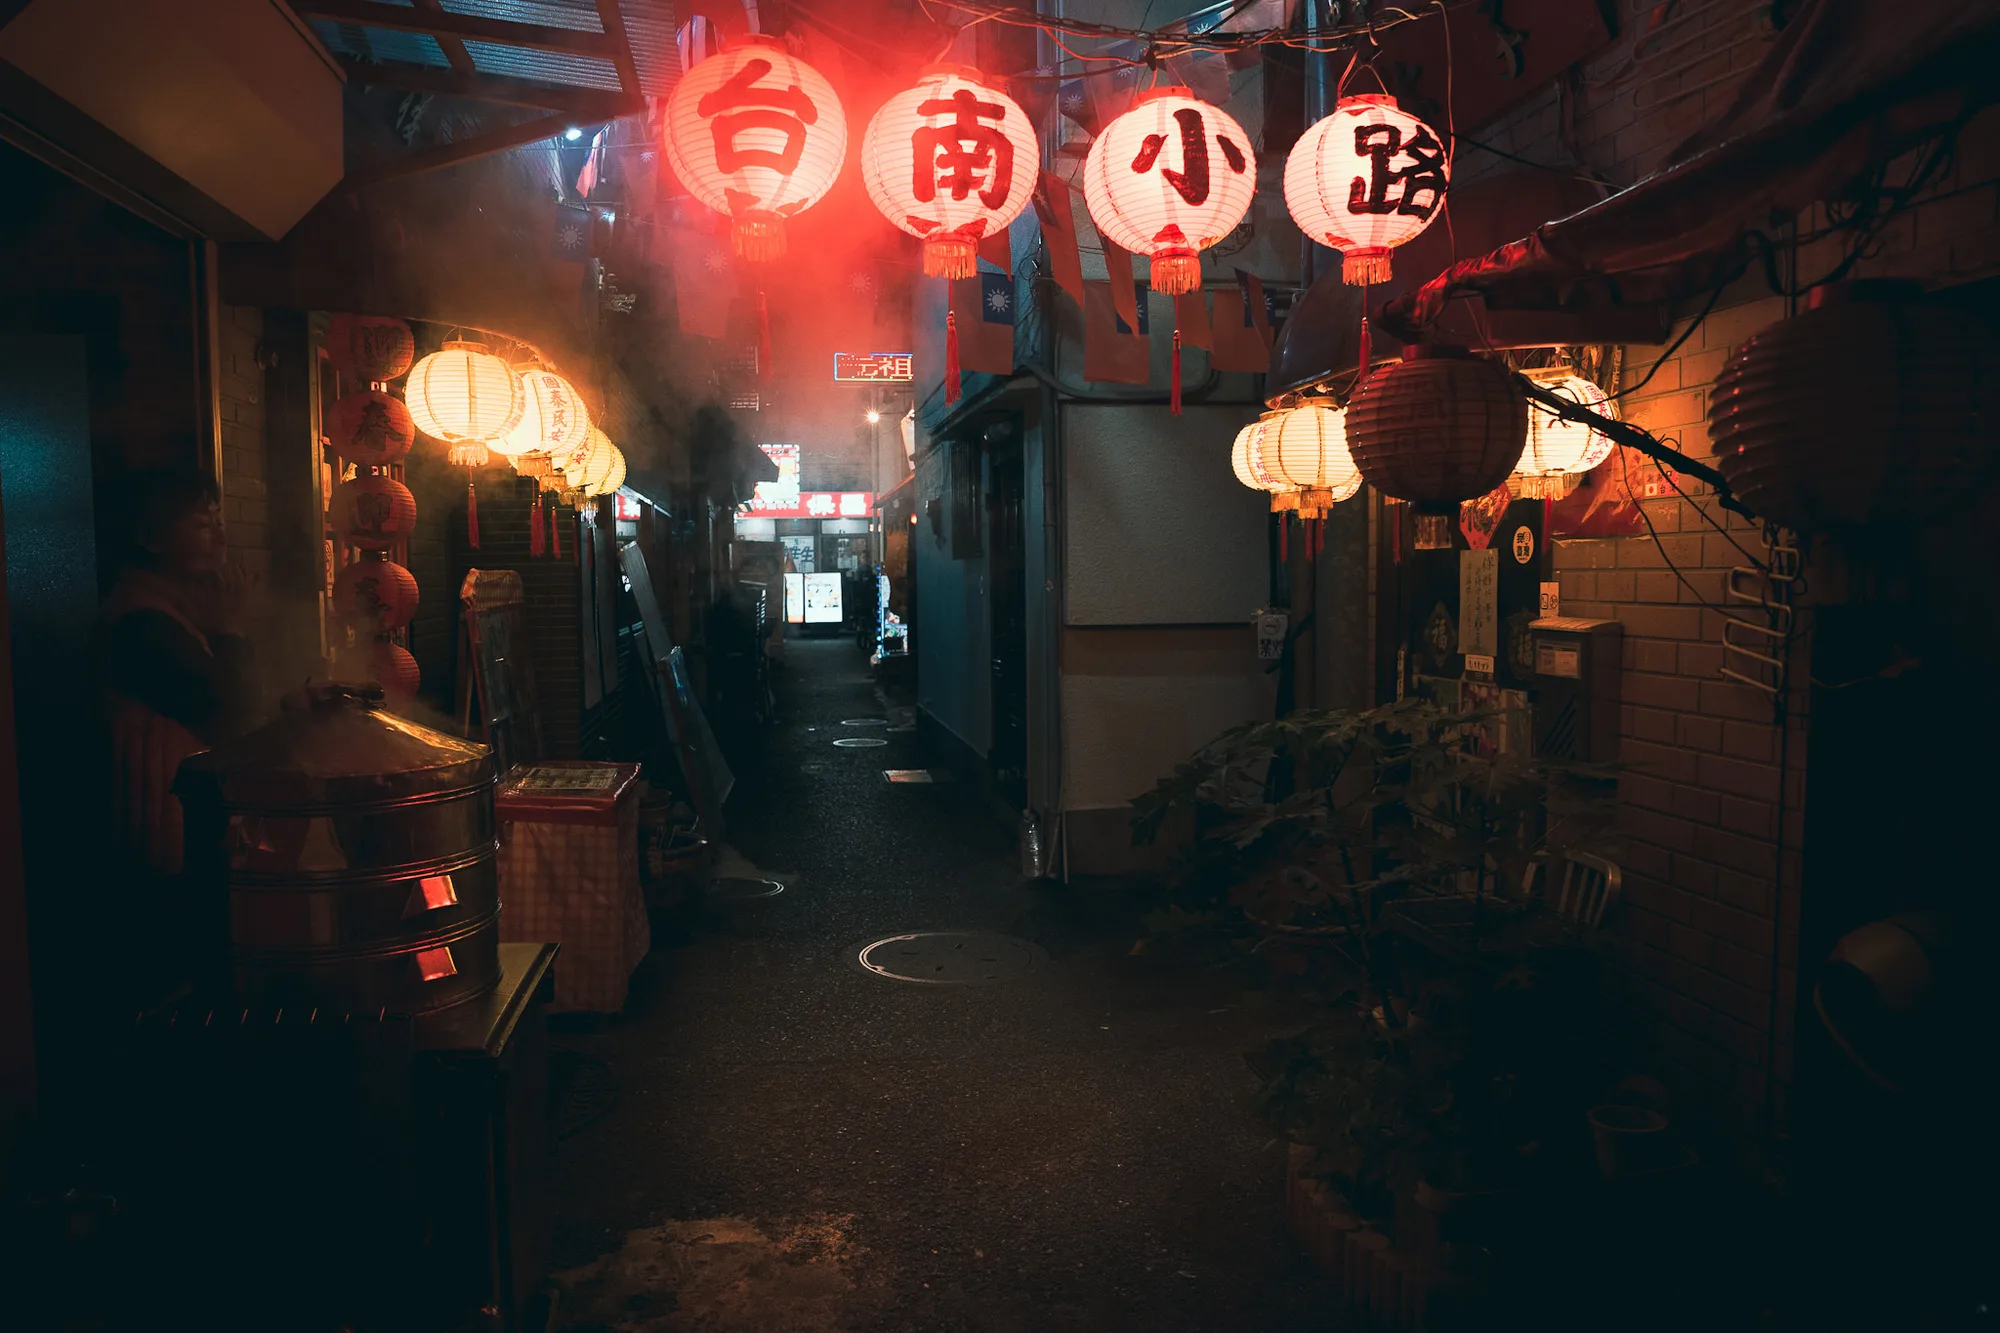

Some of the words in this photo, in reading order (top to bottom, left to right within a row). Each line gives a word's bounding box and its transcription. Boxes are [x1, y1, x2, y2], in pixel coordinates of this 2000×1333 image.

[698, 59, 817, 176] 台
[912, 90, 1012, 210] 南
[1131, 108, 1245, 206] 小
[1347, 124, 1449, 221] 路
[352, 399, 404, 452] 春
[541, 376, 568, 442] 國泰民安
